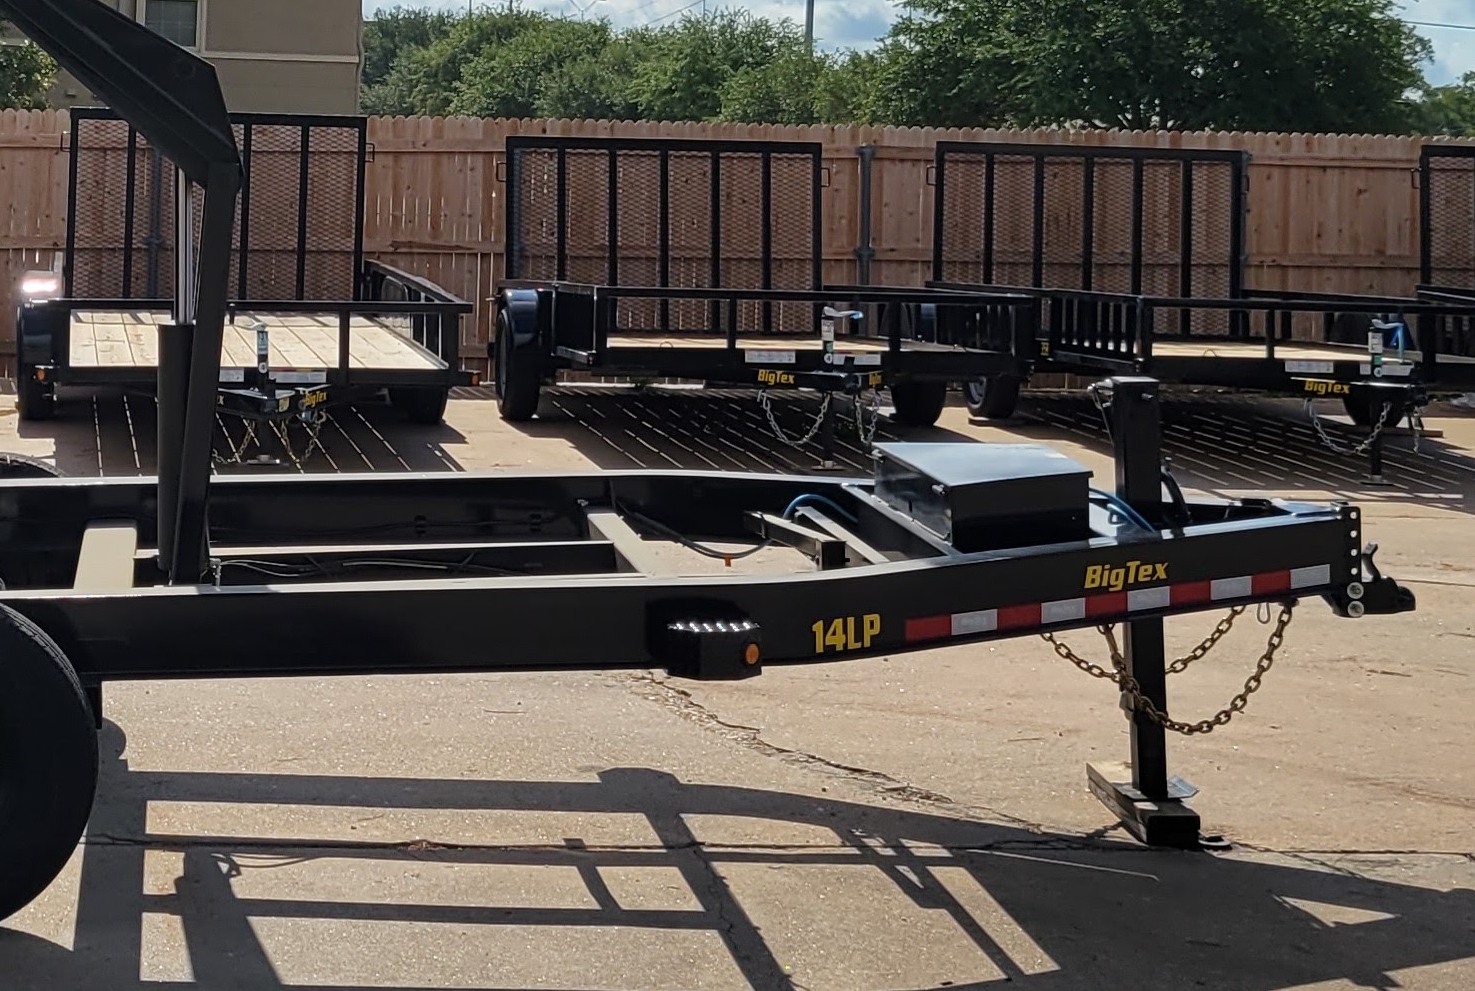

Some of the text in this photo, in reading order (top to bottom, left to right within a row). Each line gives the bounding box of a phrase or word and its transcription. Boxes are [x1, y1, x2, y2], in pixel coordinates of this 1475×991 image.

[758, 369, 795, 385] BigTex
[1304, 380, 1350, 395] BigTex
[1084, 561, 1168, 591] BigTex
[812, 613, 881, 653] 14LP
